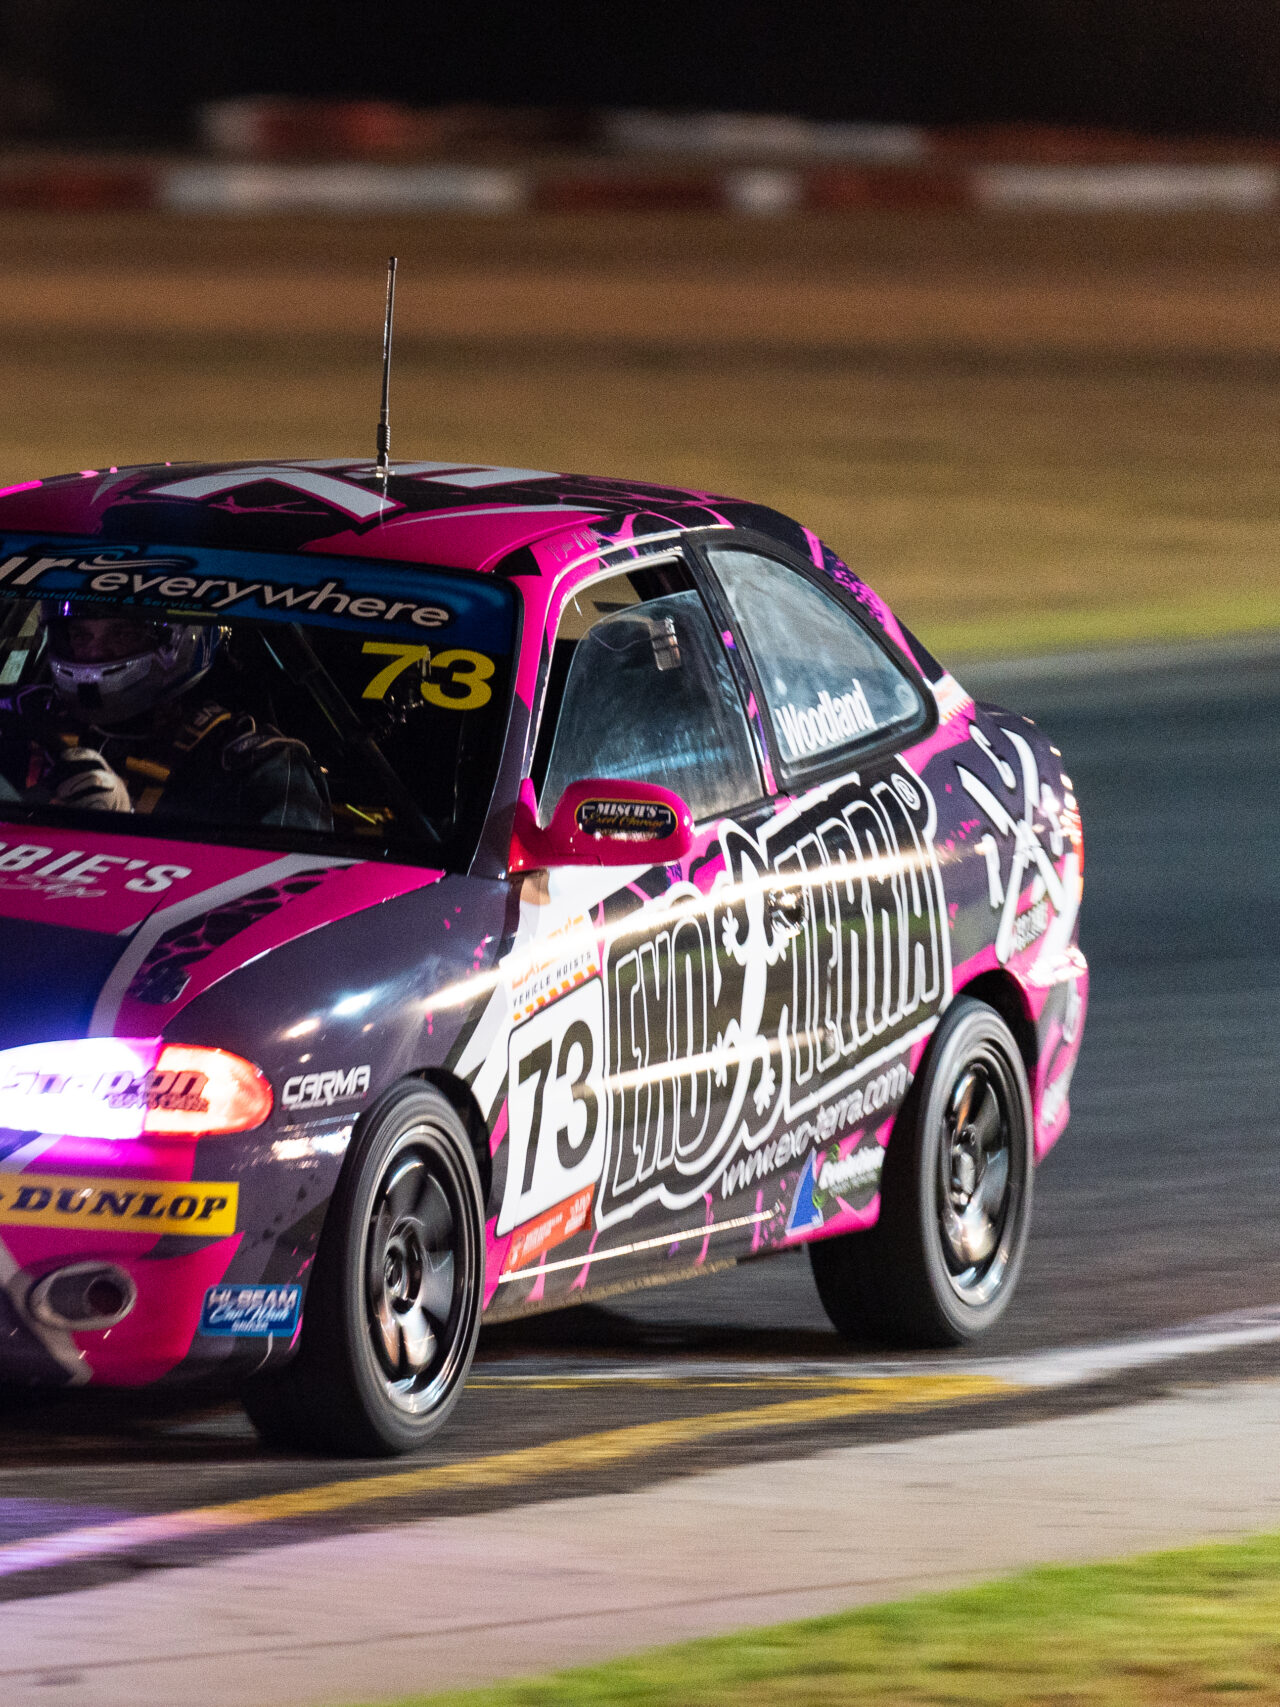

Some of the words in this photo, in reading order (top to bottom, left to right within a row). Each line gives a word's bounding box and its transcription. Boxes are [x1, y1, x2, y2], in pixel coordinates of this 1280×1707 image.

[26, 589, 117, 603] Installation
[143, 597, 204, 610] Service
[91, 571, 450, 628] everywhere
[360, 640, 496, 711] 73
[512, 975, 552, 1009] VEHICLE
[555, 950, 593, 981] HOISTS
[281, 1064, 371, 1107] CARMA
[517, 1020, 596, 1200] 73
[9, 1184, 228, 1222] DUNLOP
